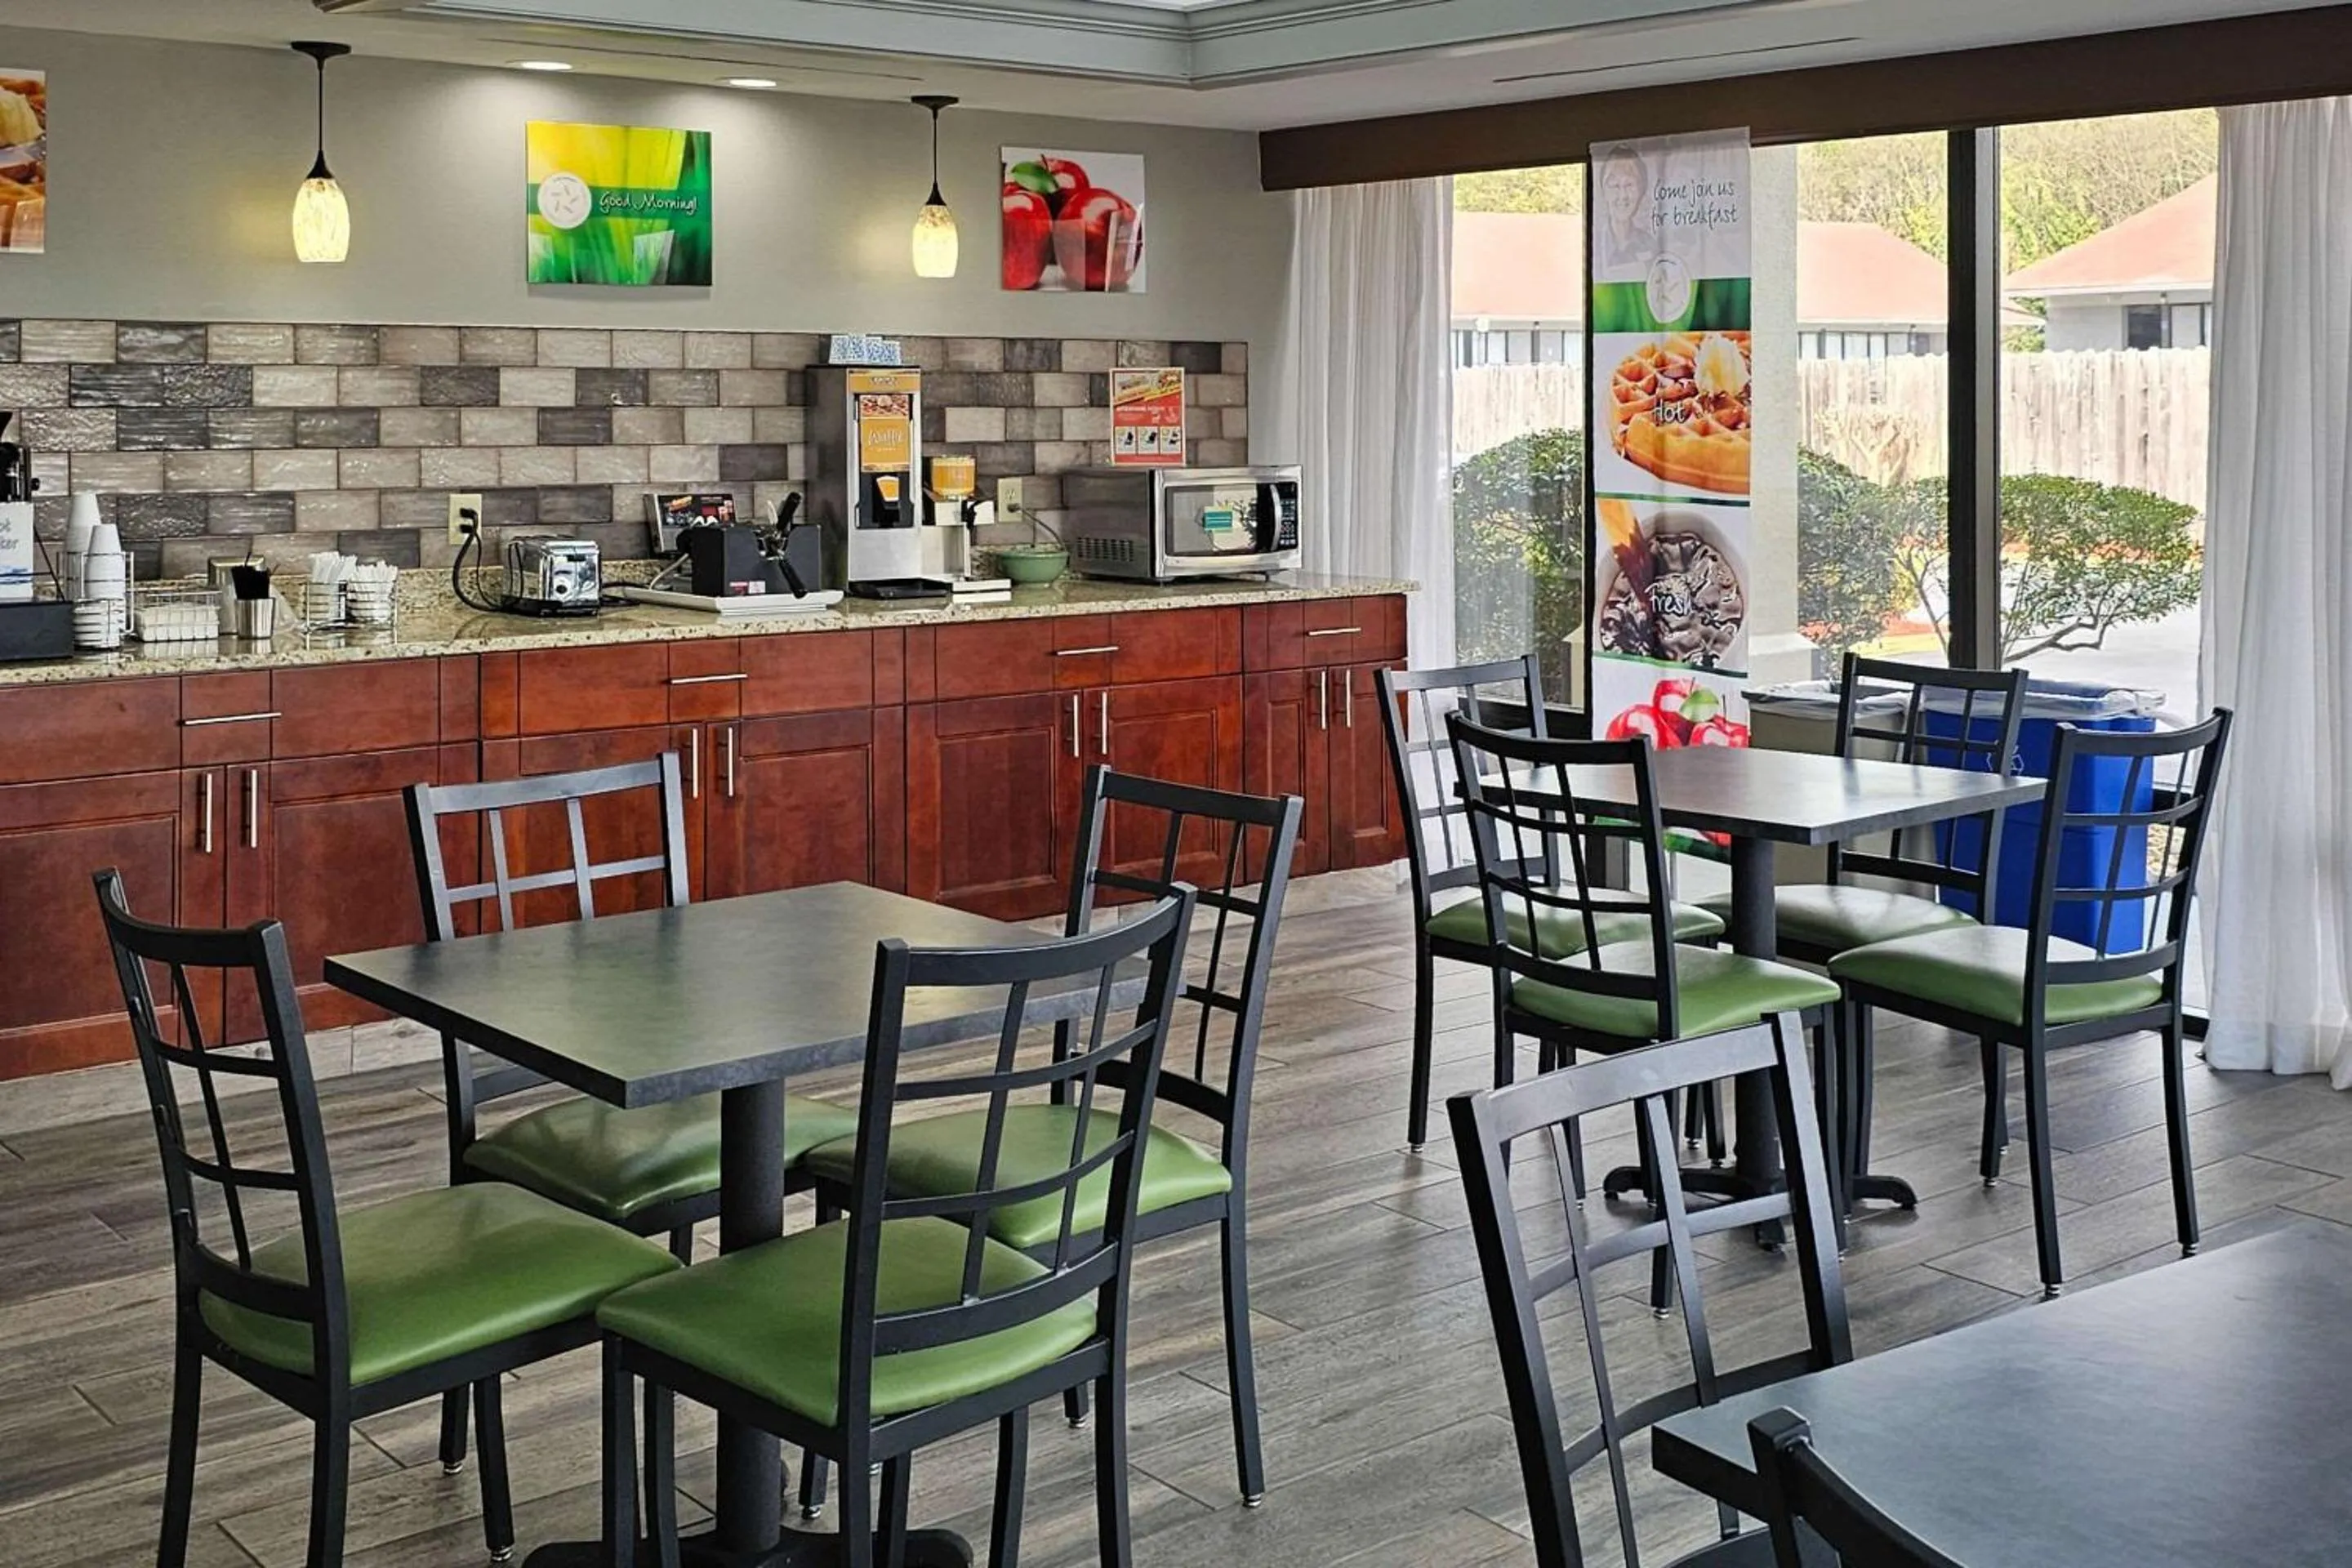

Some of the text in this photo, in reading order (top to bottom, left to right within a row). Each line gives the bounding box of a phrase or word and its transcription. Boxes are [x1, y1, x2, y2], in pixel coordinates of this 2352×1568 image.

[600, 191, 697, 216] Good Morning!
[1654, 178, 1735, 207] Come join us
[1652, 202, 1737, 235] for breakfast
[1654, 396, 1686, 422] Hot
[1645, 582, 1691, 615] Fresh
